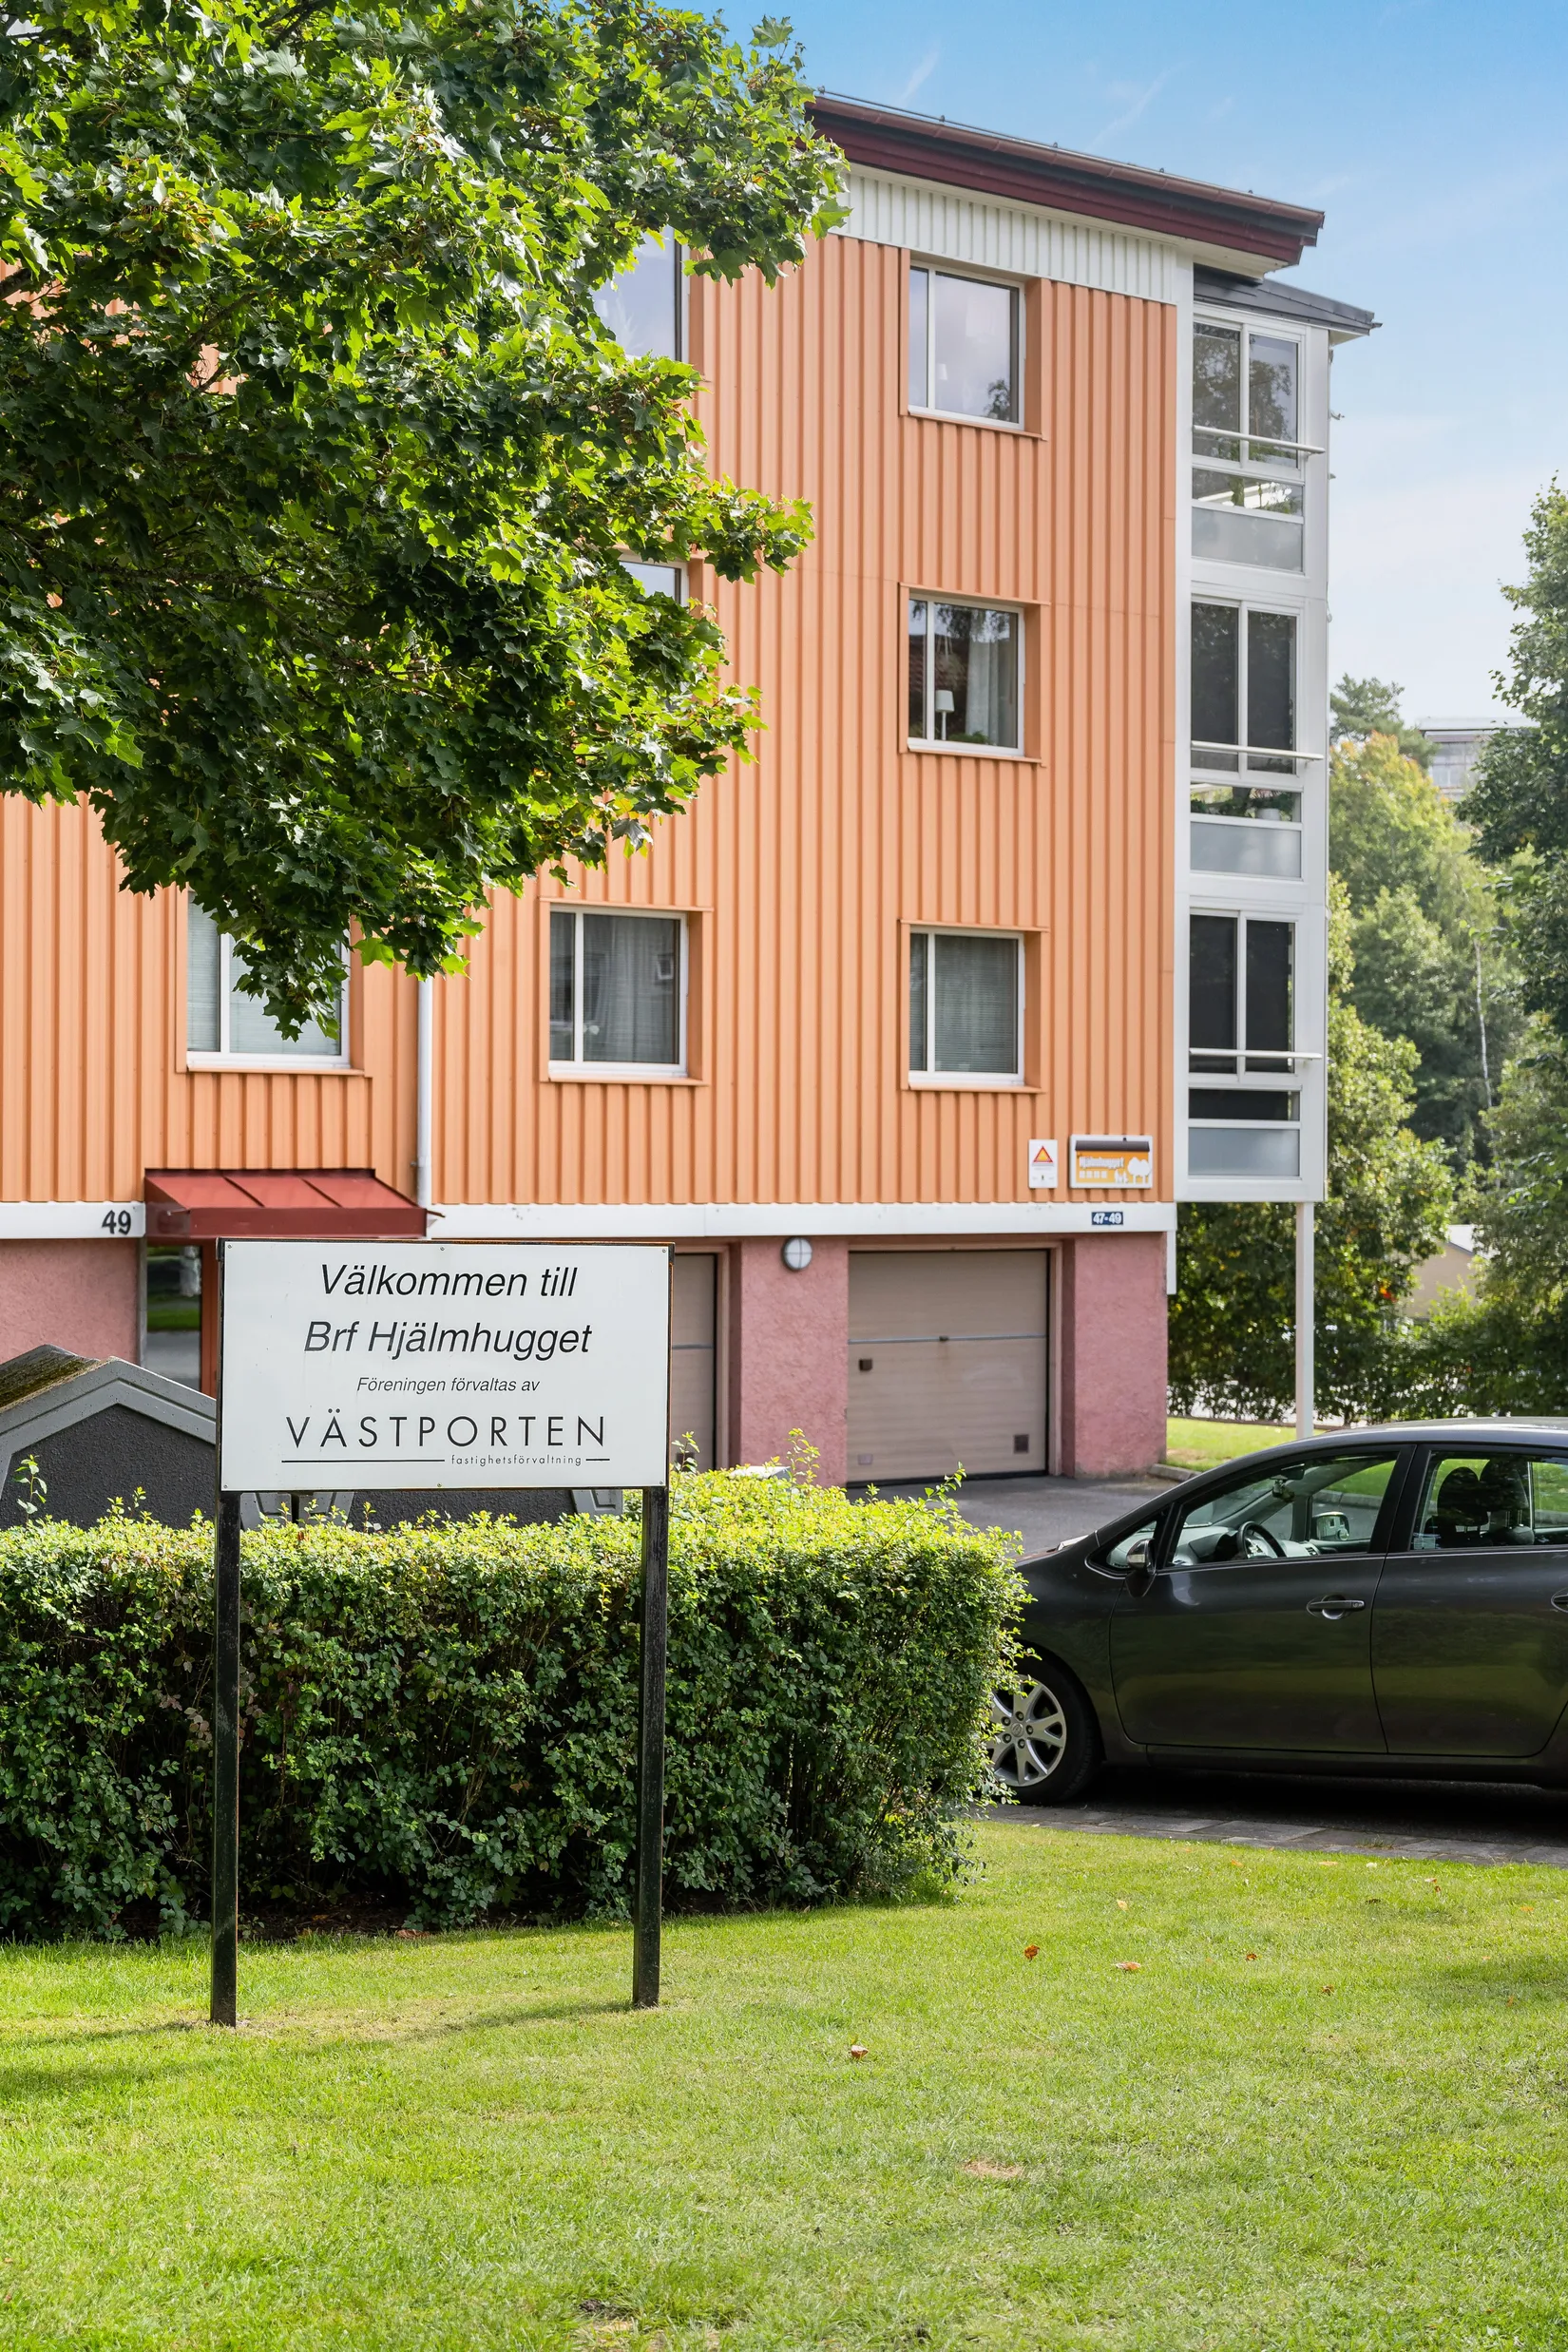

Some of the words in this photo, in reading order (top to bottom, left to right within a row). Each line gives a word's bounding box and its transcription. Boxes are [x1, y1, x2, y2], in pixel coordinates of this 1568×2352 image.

[101, 1209, 132, 1235] 49
[321, 1264, 528, 1297] Välkommen
[540, 1266, 580, 1297] till
[303, 1320, 360, 1353] Brf
[368, 1321, 594, 1363] Hjälmhugget
[355, 1377, 447, 1395] Föreningen
[449, 1377, 518, 1392] förvaltas
[520, 1380, 542, 1392] av
[285, 1407, 605, 1449] VÄSTPORTEN
[450, 1454, 583, 1468] fastighetsförvaltning
